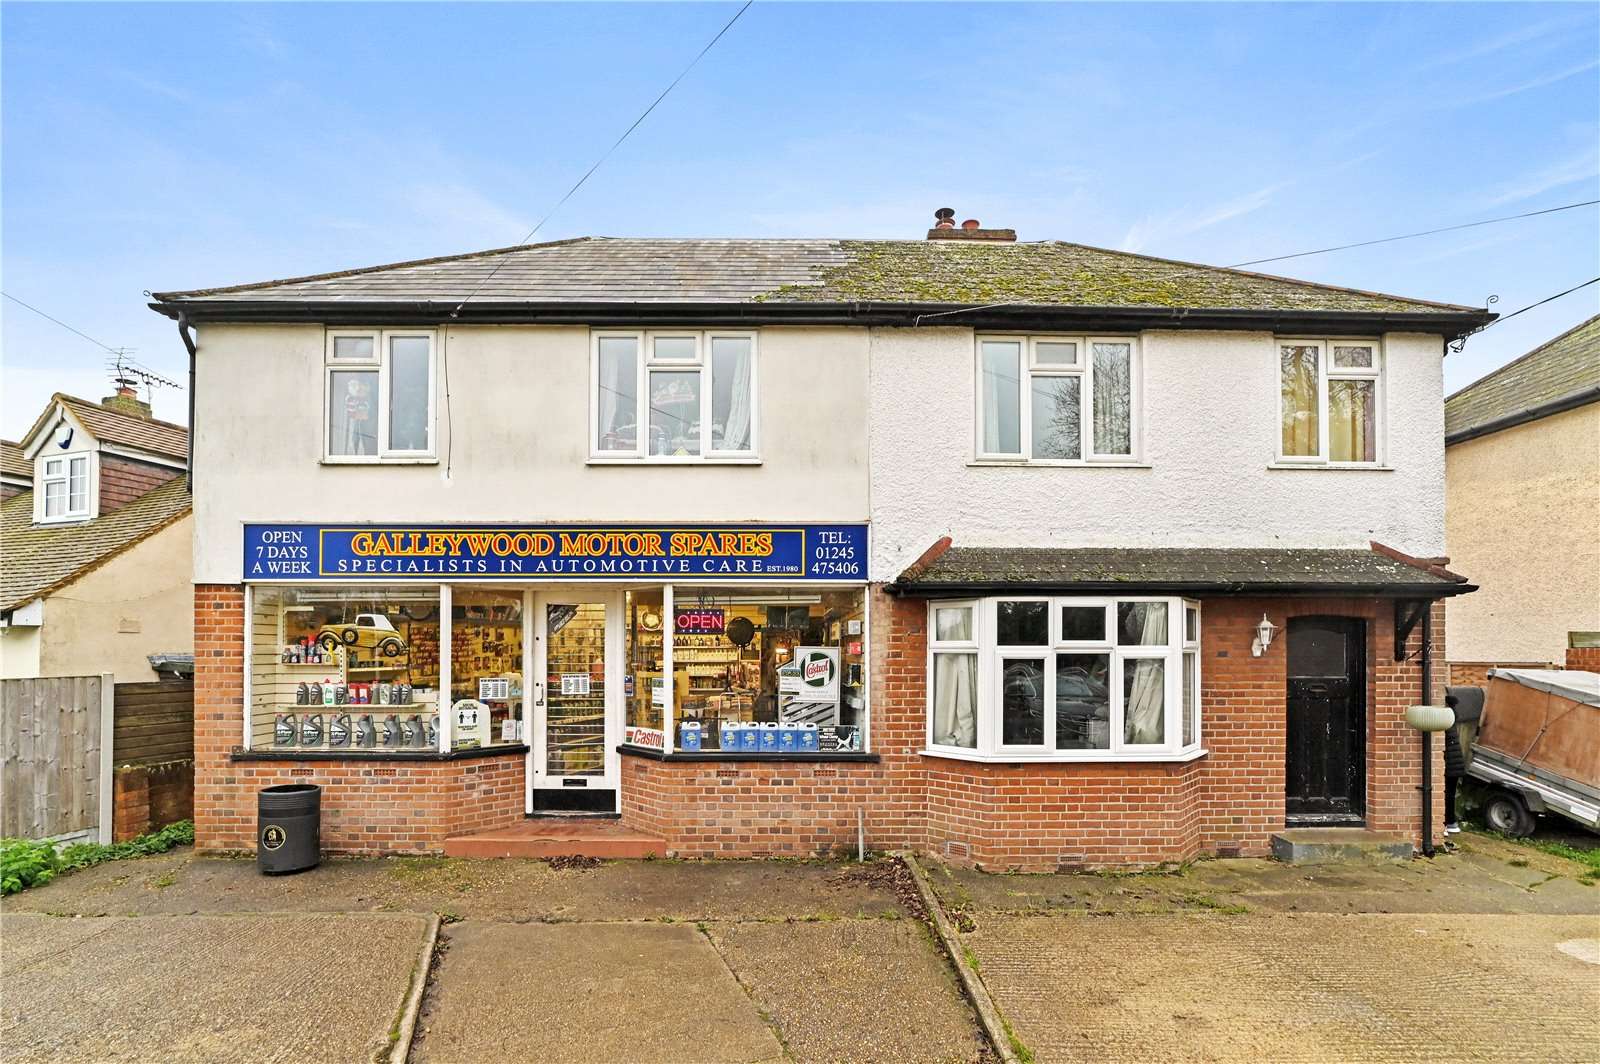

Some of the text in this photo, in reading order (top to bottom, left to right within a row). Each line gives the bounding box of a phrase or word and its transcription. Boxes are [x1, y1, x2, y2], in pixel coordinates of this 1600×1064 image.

[261, 531, 303, 544] OPEN
[351, 532, 774, 557] GALLEYWOOD MOTOR SPARES
[818, 531, 852, 544] TEL:
[256, 546, 308, 559] 7 DAYS
[815, 546, 854, 560] 01245
[252, 561, 312, 574] A WEEK
[338, 559, 763, 572] SPECIALISTS IN AUTOMOTIVE CARE
[811, 561, 859, 575] 475406
[677, 614, 723, 629] OPEN
[805, 660, 829, 679] Castrol
[633, 728, 663, 748] Castrol
